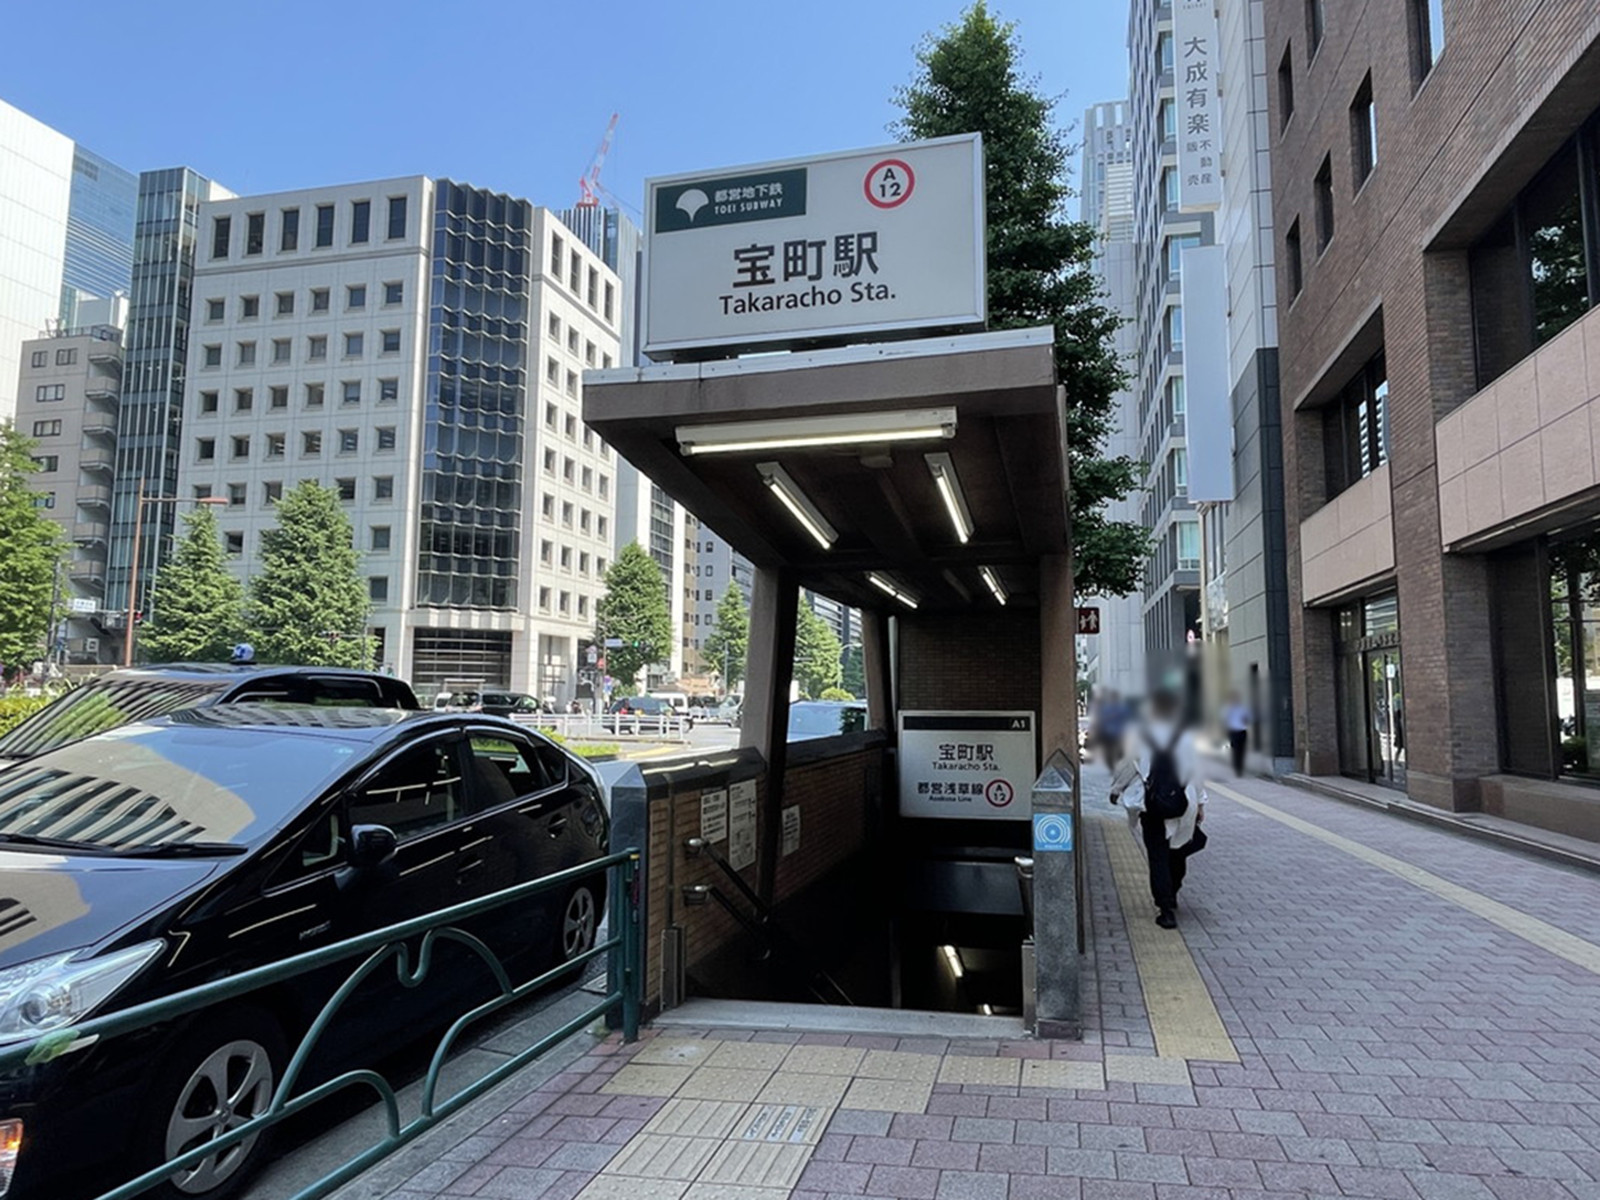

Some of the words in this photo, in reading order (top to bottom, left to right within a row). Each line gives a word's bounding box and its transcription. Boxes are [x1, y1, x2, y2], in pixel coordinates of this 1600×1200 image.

[1184, 36, 1209, 135] 大成有楽
[1200, 139, 1213, 184] 不動産
[883, 168, 896, 182] A
[714, 182, 783, 202] 都営地下鉄
[879, 182, 901, 198] 12
[714, 204, 736, 215] TOEI
[740, 198, 783, 212] SUBWAY
[732, 231, 879, 288] 宝町駅
[719, 284, 842, 316] Takaracho
[850, 281, 896, 303] Sta.
[1011, 719, 1026, 729] A1
[938, 743, 994, 761] 宝町駅
[932, 761, 981, 771] Takaracho
[982, 762, 1001, 771] Sta.
[917, 782, 984, 795] 都営浅草線
[995, 784, 1003, 792] A
[993, 793, 1006, 802] 12
